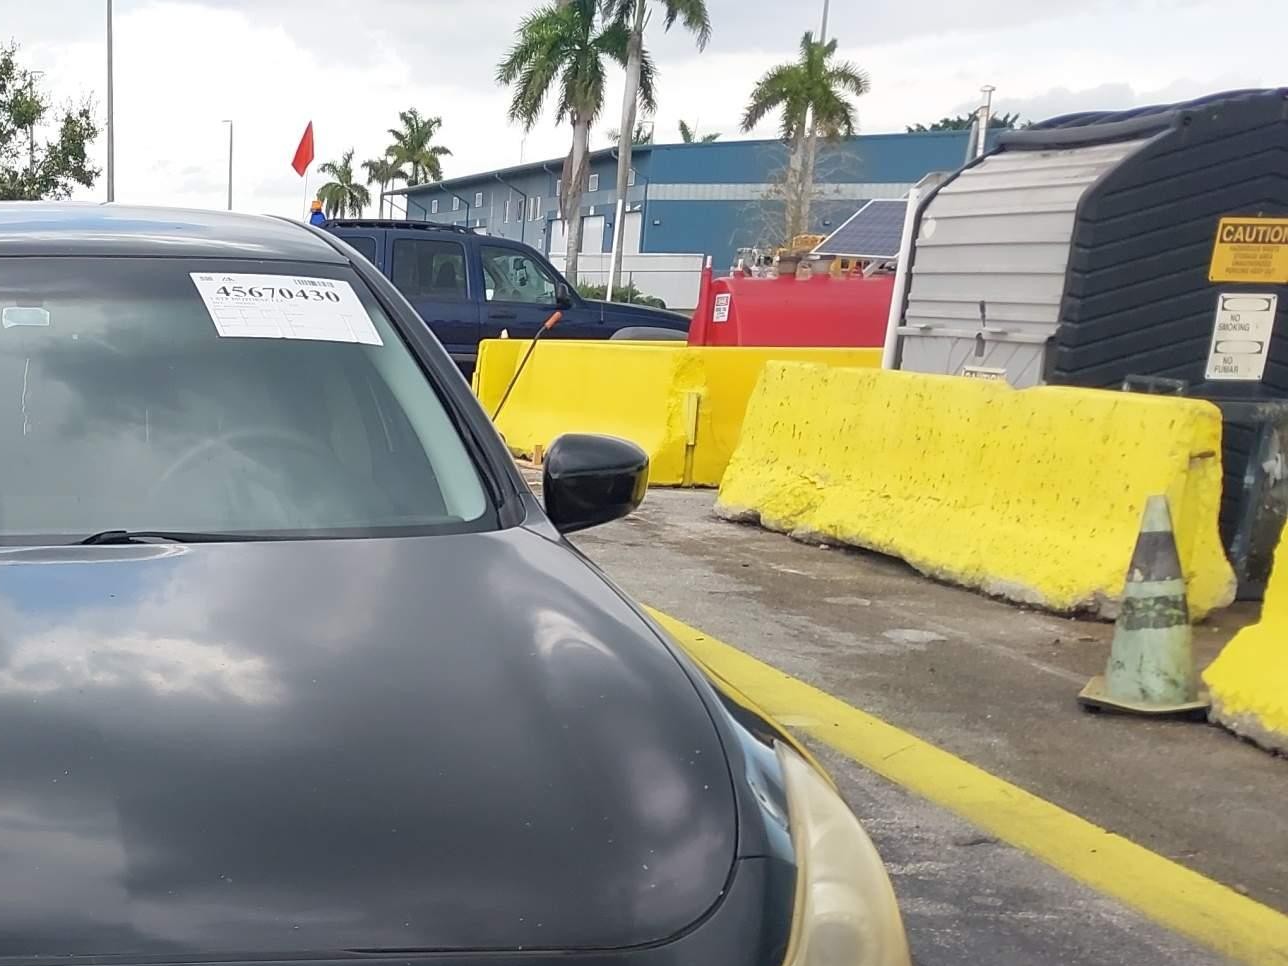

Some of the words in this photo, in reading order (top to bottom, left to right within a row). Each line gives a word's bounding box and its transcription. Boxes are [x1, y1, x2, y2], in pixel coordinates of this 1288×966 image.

[216, 286, 340, 302] 45670430
[1217, 323, 1250, 331] SMOKING
[1223, 356, 1233, 365] NO
